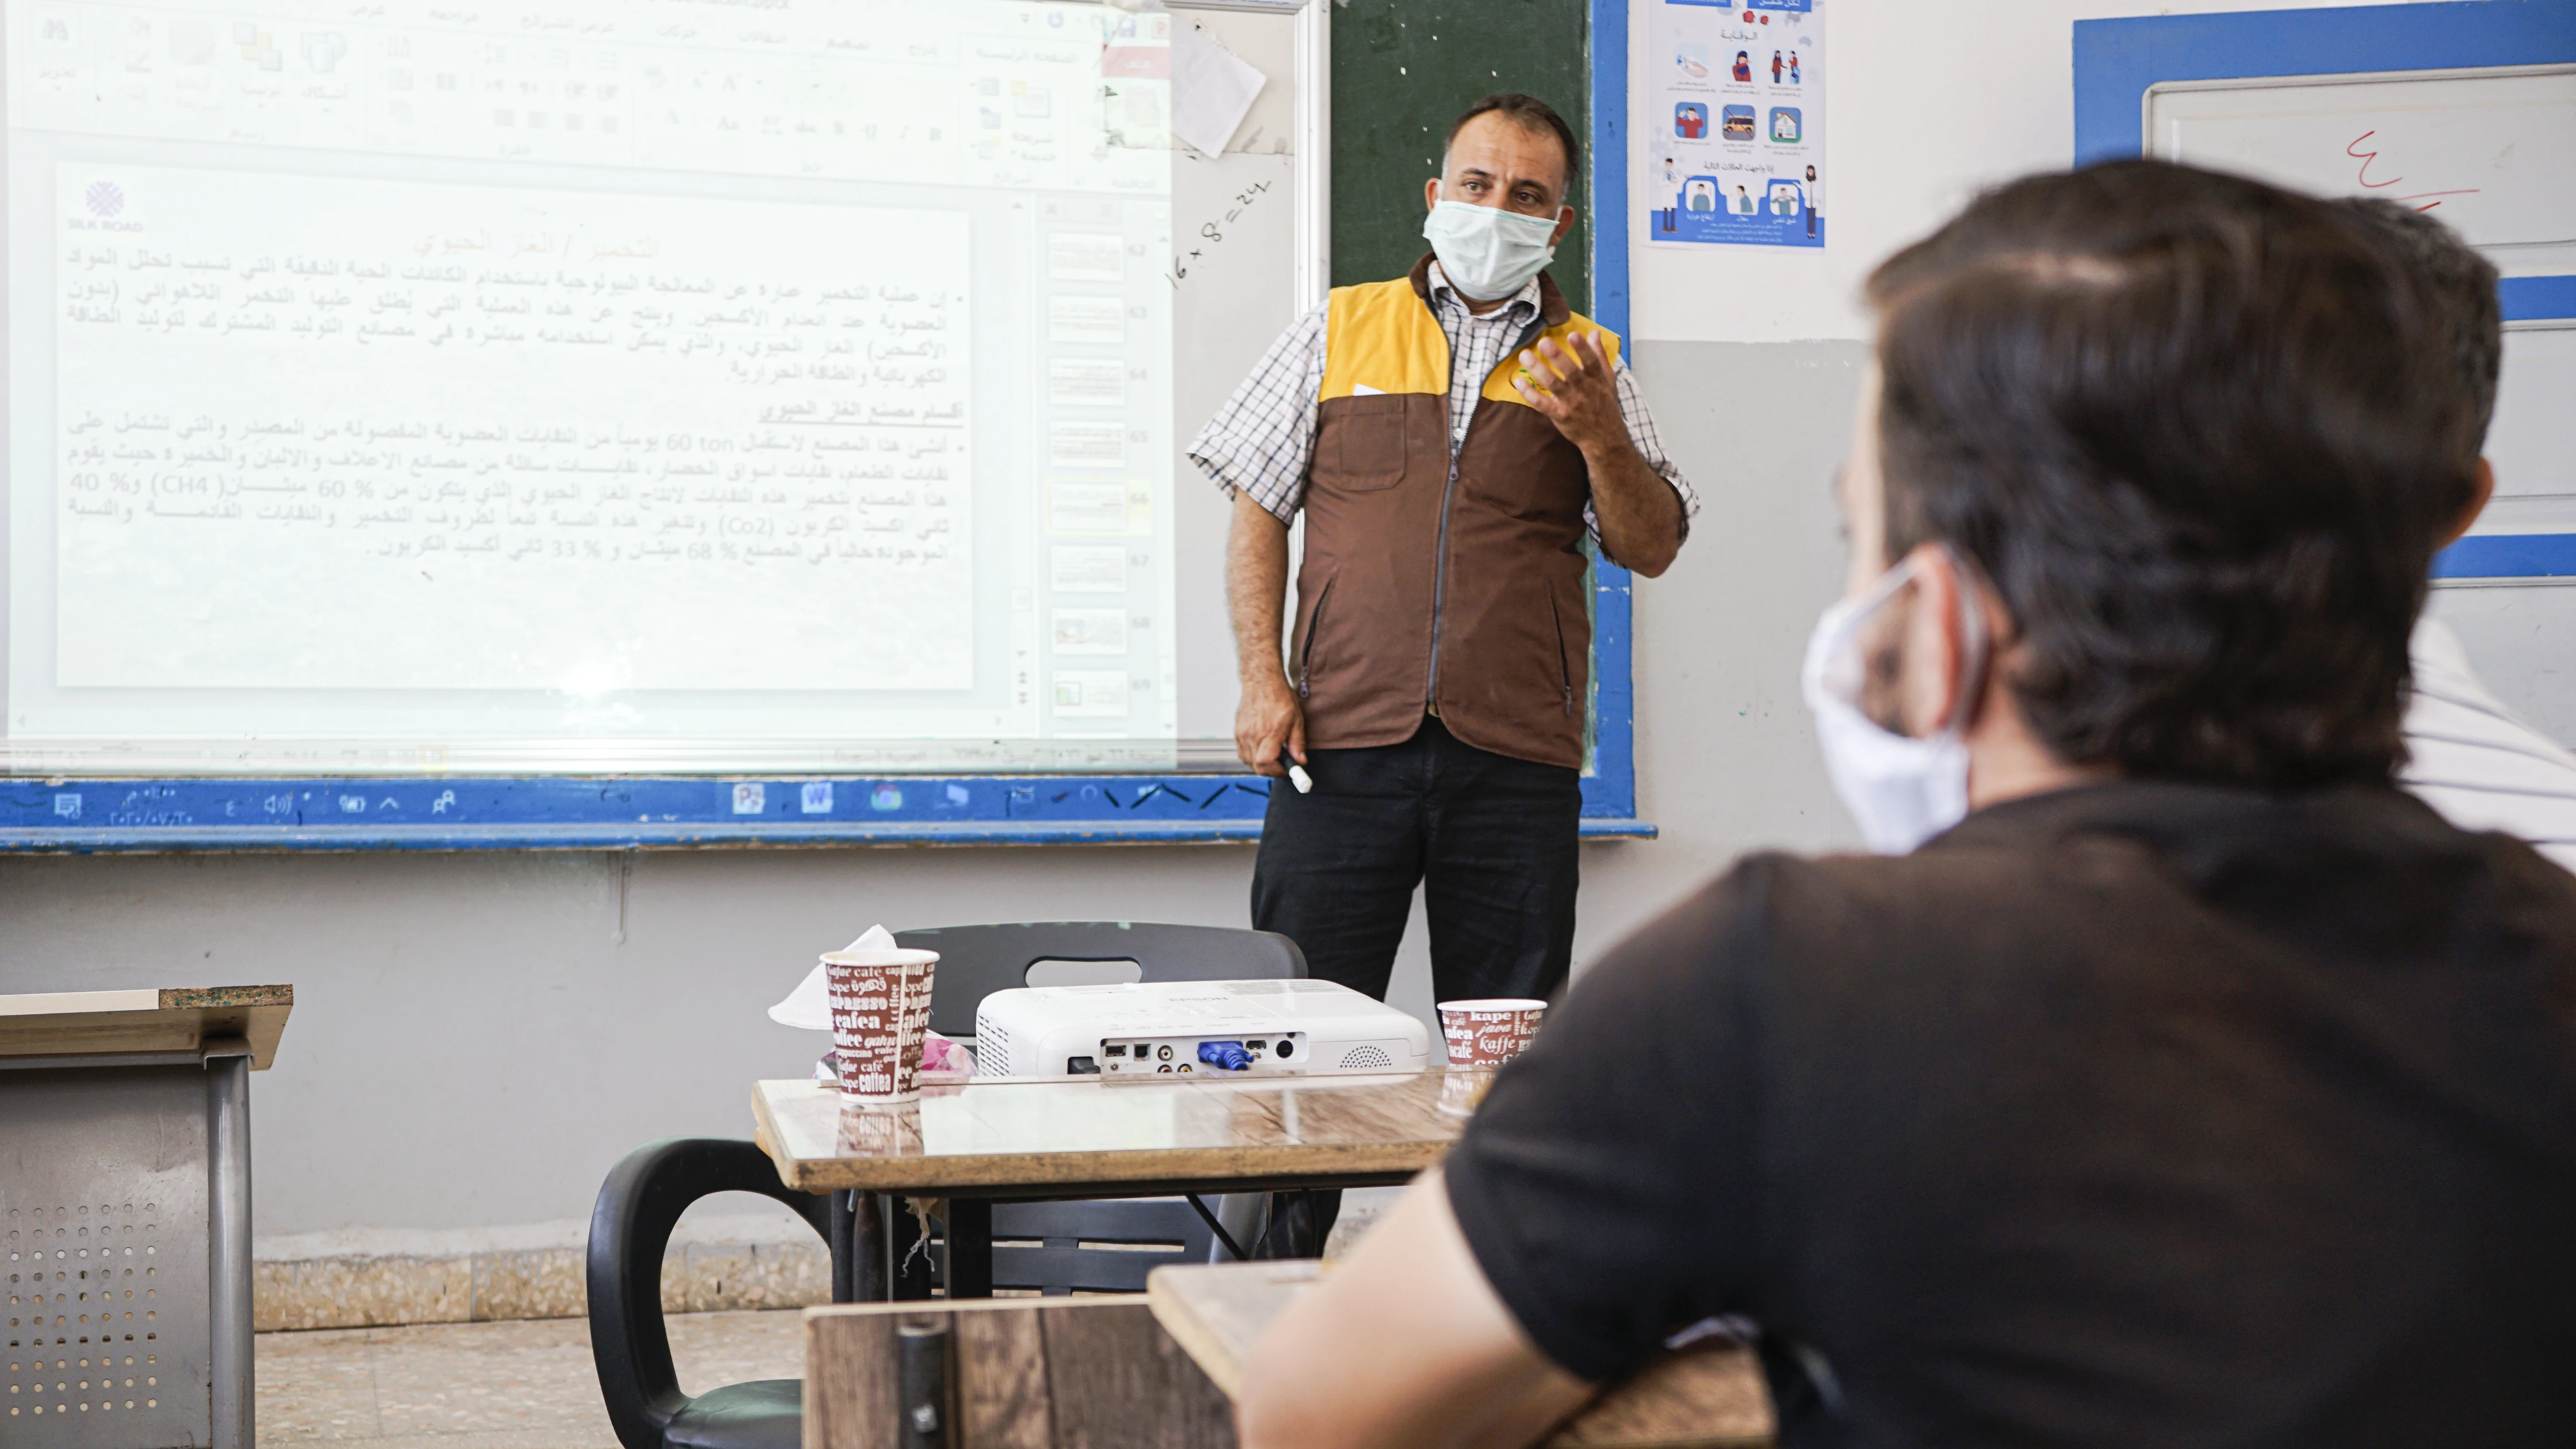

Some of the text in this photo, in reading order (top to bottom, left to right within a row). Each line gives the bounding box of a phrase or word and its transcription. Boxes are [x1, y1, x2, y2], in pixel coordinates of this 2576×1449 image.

[67, 218, 144, 233] SILK ROAD
[412, 227, 492, 258] الحيوي
[586, 235, 660, 263] التخمير
[665, 433, 693, 452] 60
[699, 436, 734, 452] ton
[70, 472, 100, 491] 40
[317, 479, 346, 498] 60
[551, 540, 577, 558] 33
[687, 542, 714, 561] 68
[1470, 1011, 1512, 1024] kape
[1475, 1022, 1513, 1038] java
[1479, 1035, 1516, 1055] kaffe
